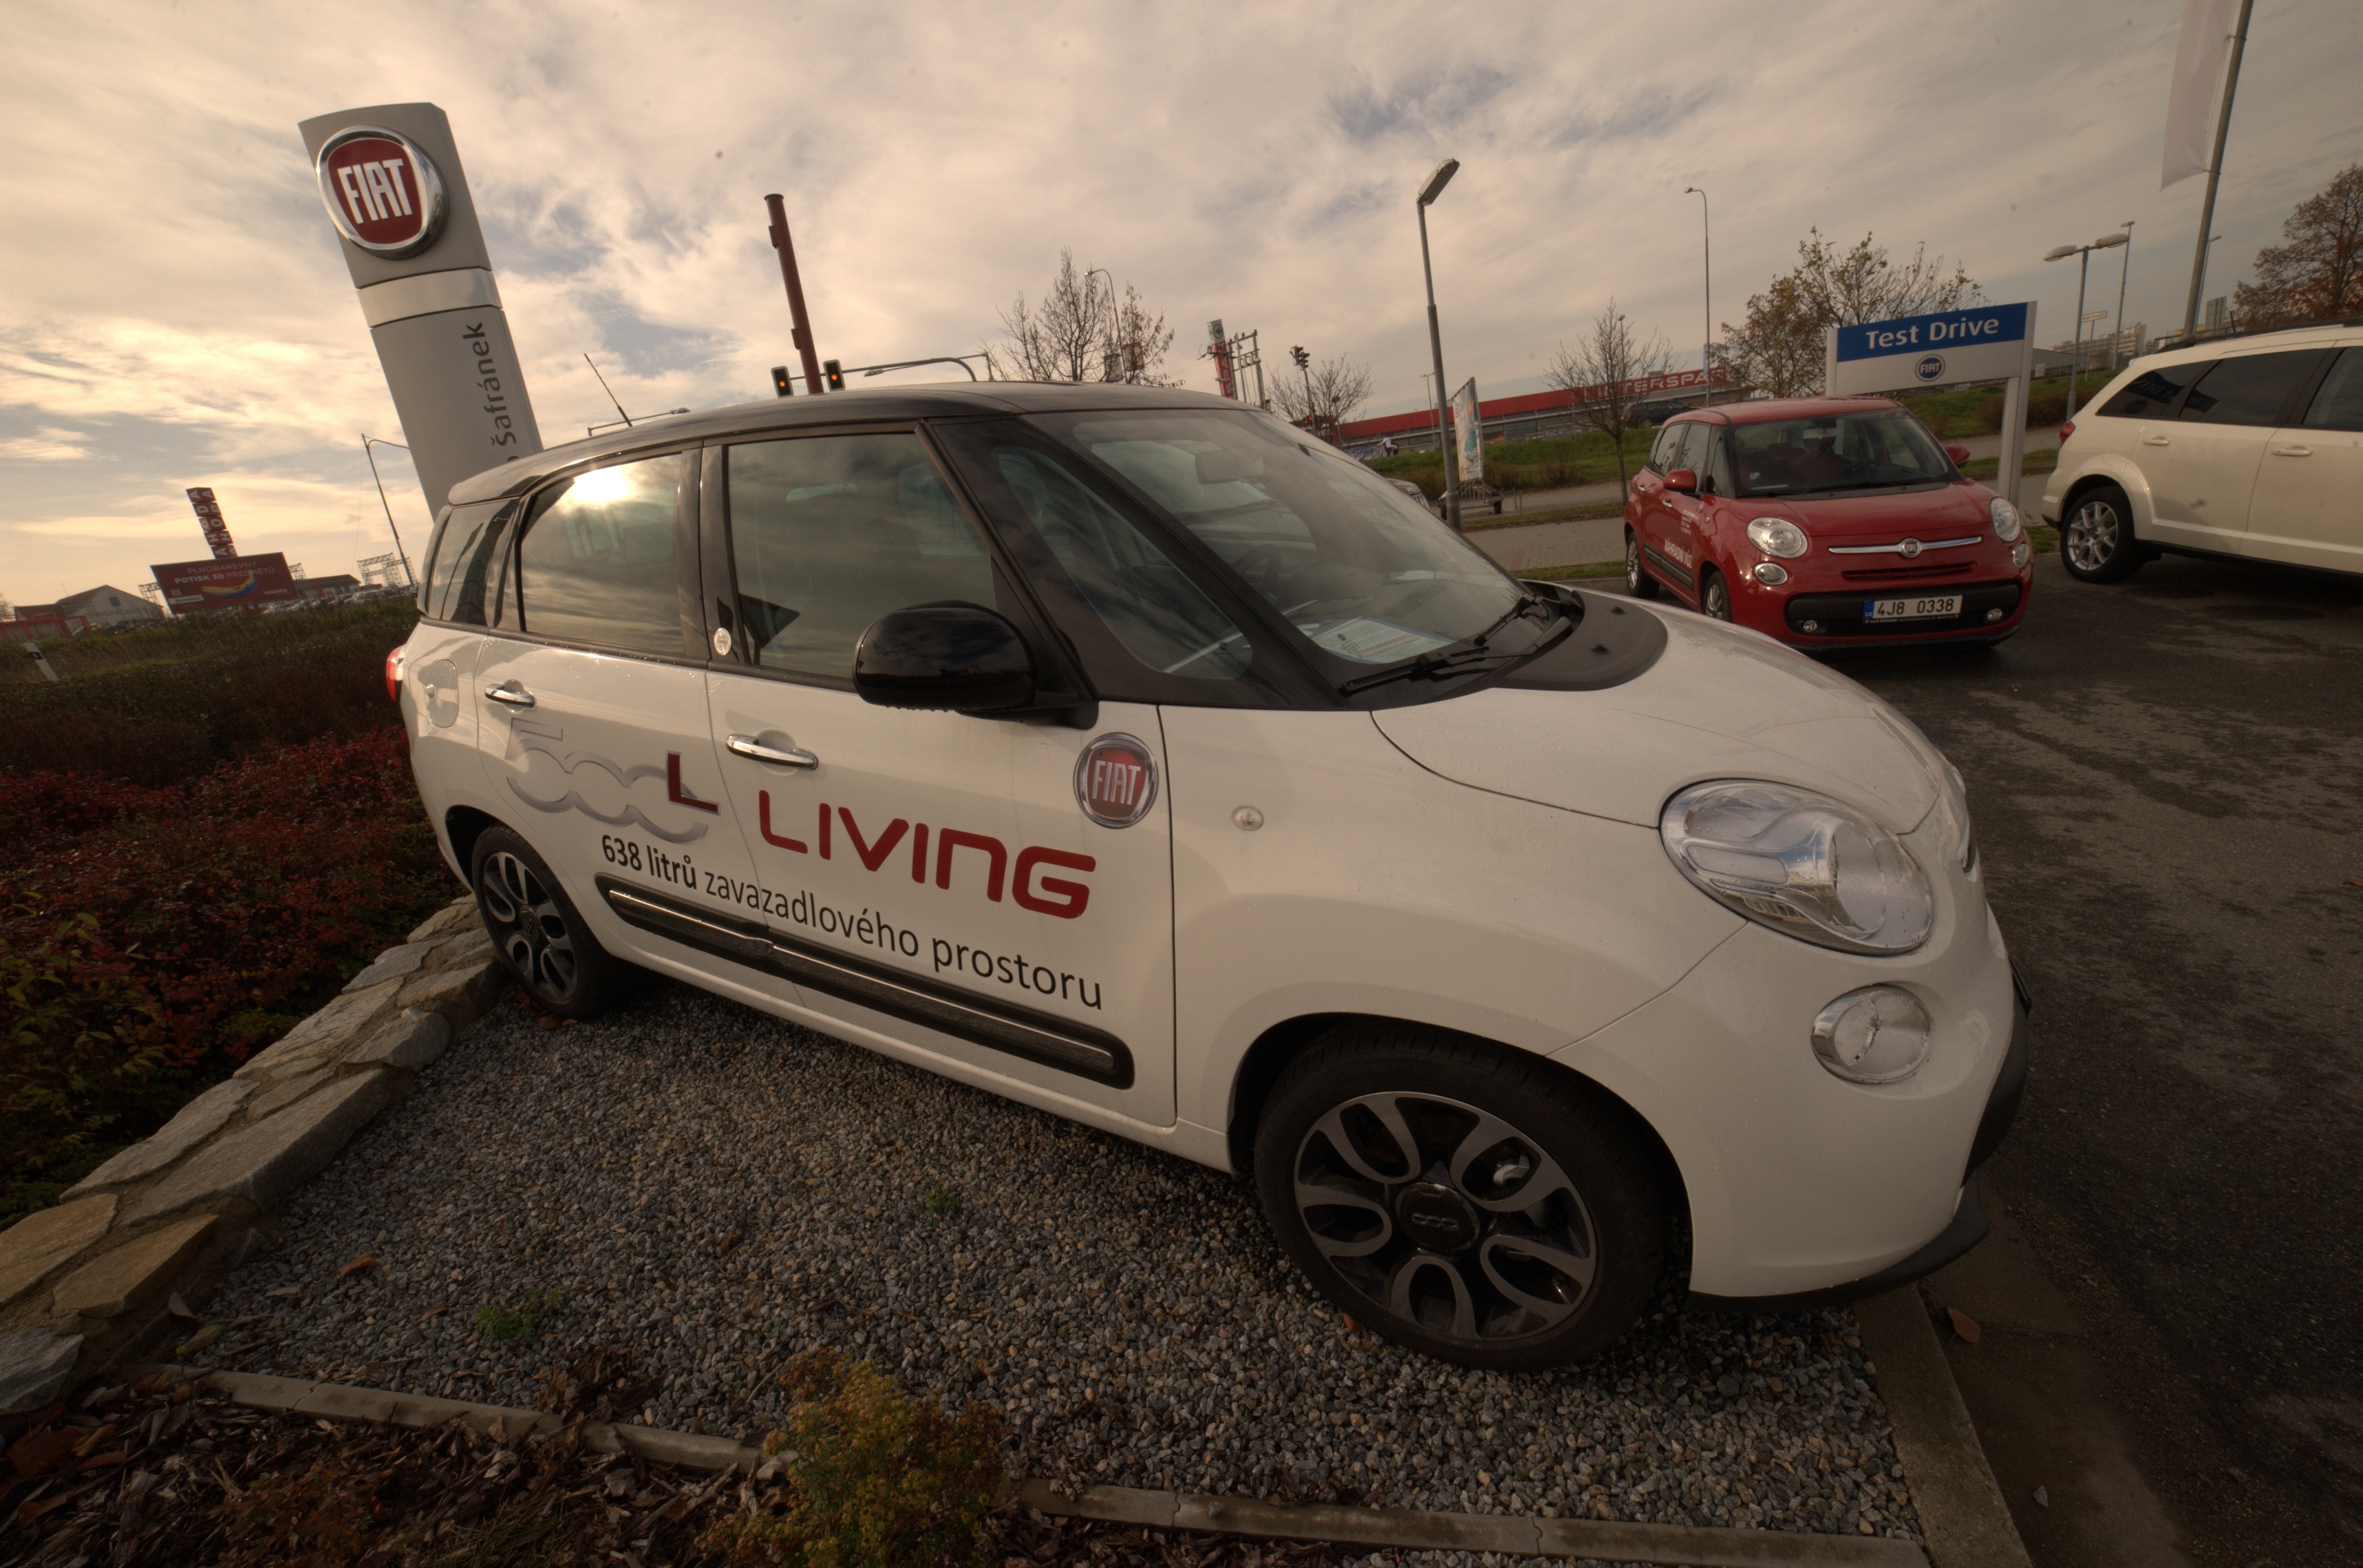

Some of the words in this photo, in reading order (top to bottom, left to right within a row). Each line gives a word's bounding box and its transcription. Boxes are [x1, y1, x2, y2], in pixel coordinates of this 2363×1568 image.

[336, 158, 413, 226] FIAT
[1866, 325, 1919, 349] Test
[1929, 317, 1999, 341] Drive
[462, 321, 518, 447] Šafránek
[1218, 342, 1233, 395] SPAR
[1919, 362, 1941, 374] FIAT
[187, 561, 257, 574] PLNOBAREVNÝ
[1906, 544, 1916, 552] FIAT
[174, 574, 210, 584] POTISK
[227, 567, 275, 579] PŘEDMĚTŮ
[1877, 601, 1905, 616] 4J8
[1916, 598, 1954, 614] 0338
[1090, 757, 1142, 807] FIAT
[759, 789, 1097, 920] LIVING
[601, 833, 643, 872] 638
[647, 847, 698, 891] litrů
[705, 869, 919, 959] zavazadlového
[932, 934, 1103, 1011] prostoru
